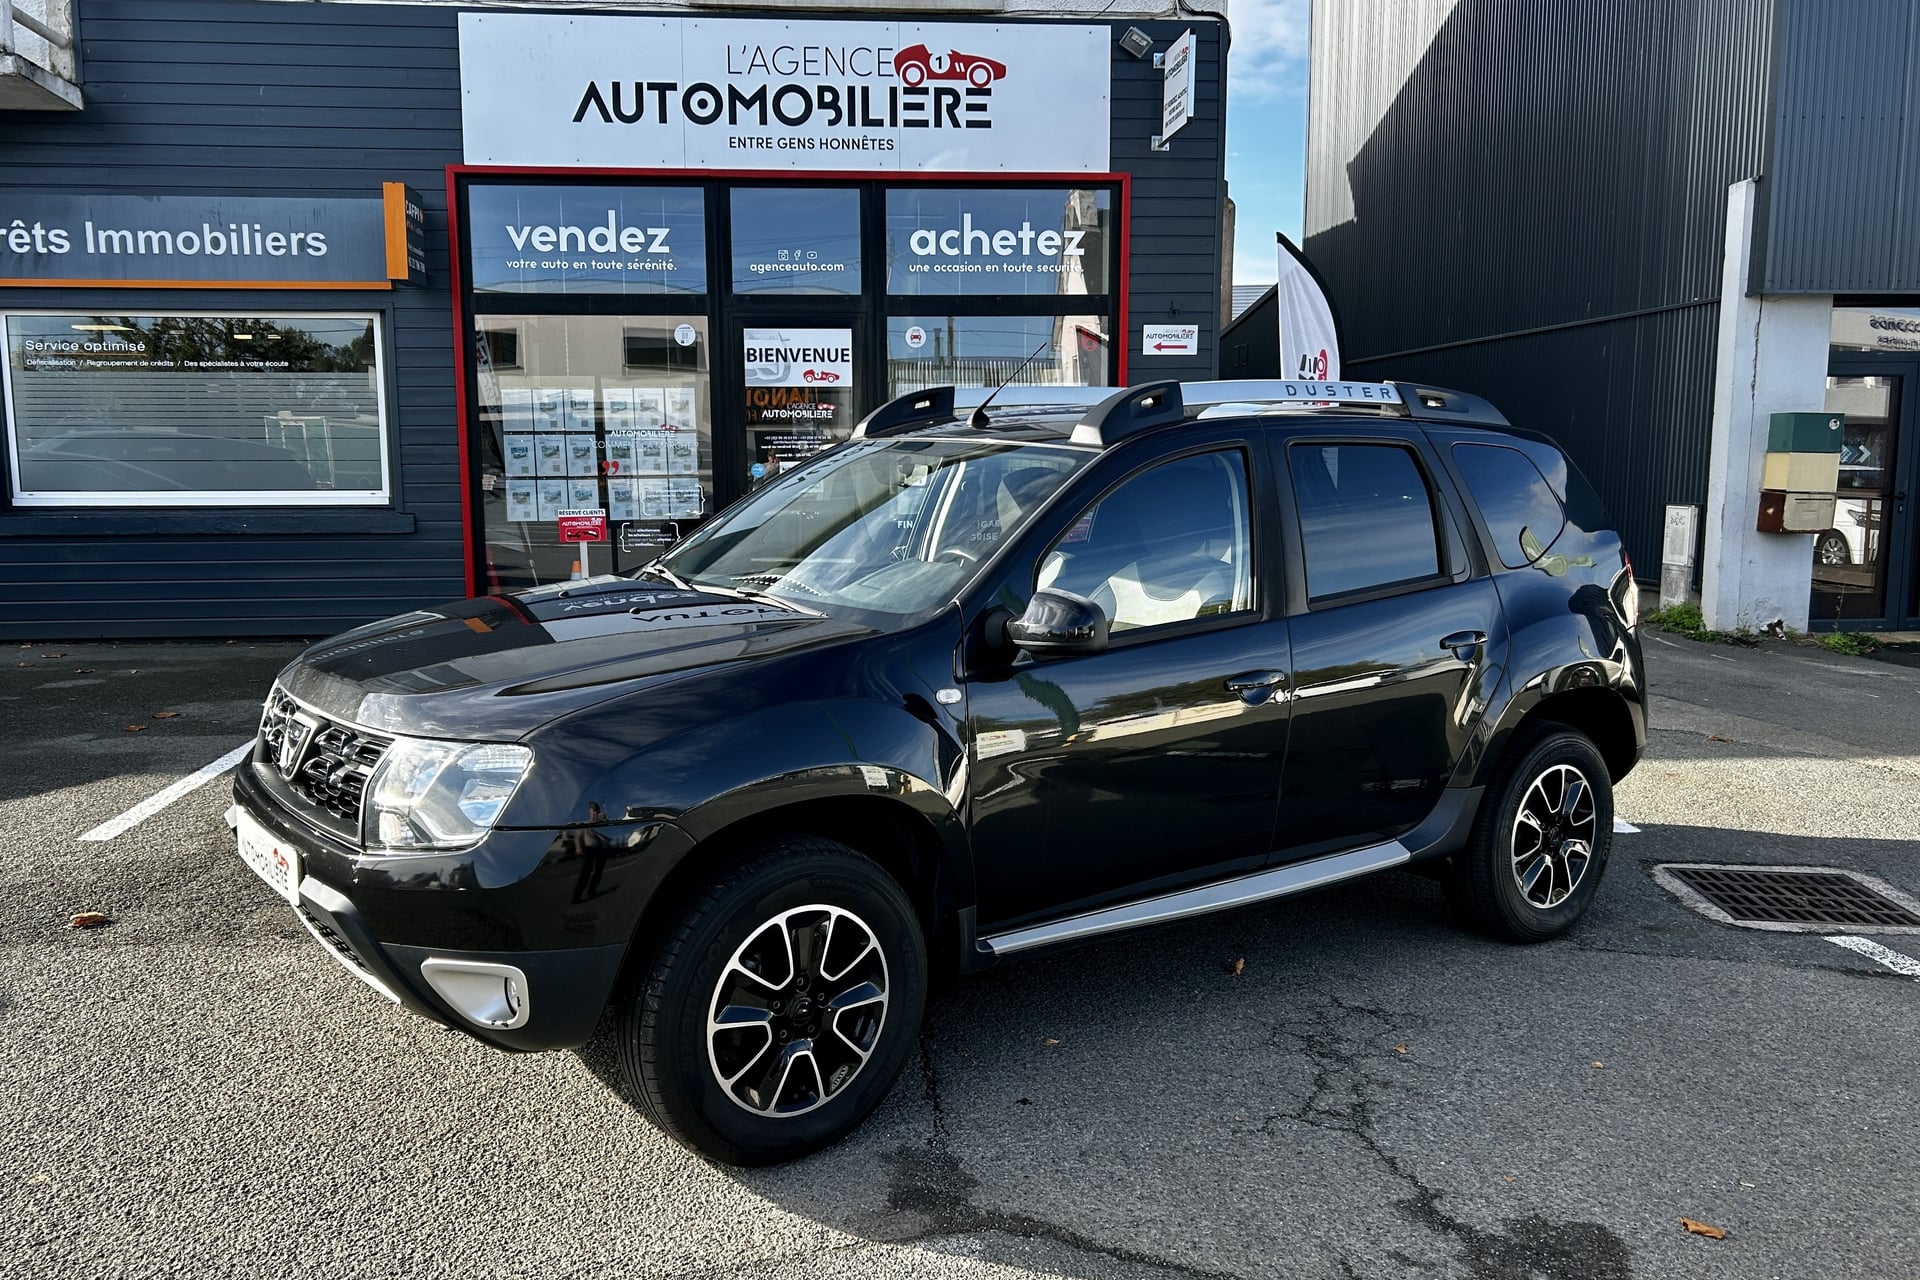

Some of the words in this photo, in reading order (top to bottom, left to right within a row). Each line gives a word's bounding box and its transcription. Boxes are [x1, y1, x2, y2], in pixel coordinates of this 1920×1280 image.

[727, 44, 894, 77] L'AGENCE
[728, 136, 773, 149] ENTRE
[777, 137, 816, 150] GENS
[819, 134, 895, 152] HONNÊTES
[85, 221, 328, 257] Immobiliers
[505, 209, 670, 254] vendez
[909, 212, 1086, 256] achetez
[505, 259, 537, 270] votre
[541, 260, 569, 270] auto
[572, 262, 588, 270] en
[591, 260, 624, 271] toute
[627, 258, 678, 272] sérénité.
[749, 260, 845, 274] agenceauto.com
[909, 263, 930, 273] une
[933, 261, 982, 273] occasion
[985, 263, 999, 273] en
[1002, 261, 1033, 273] toute
[25, 340, 80, 352] Service
[83, 340, 146, 355] optimisé
[745, 347, 851, 363] BIENVENUE
[26, 358, 77, 367] Défiscalisation
[86, 359, 138, 369] Regroupement
[199, 359, 239, 369] spécialistes
[265, 359, 289, 368] écoute
[1284, 384, 1392, 399] DUSTER
